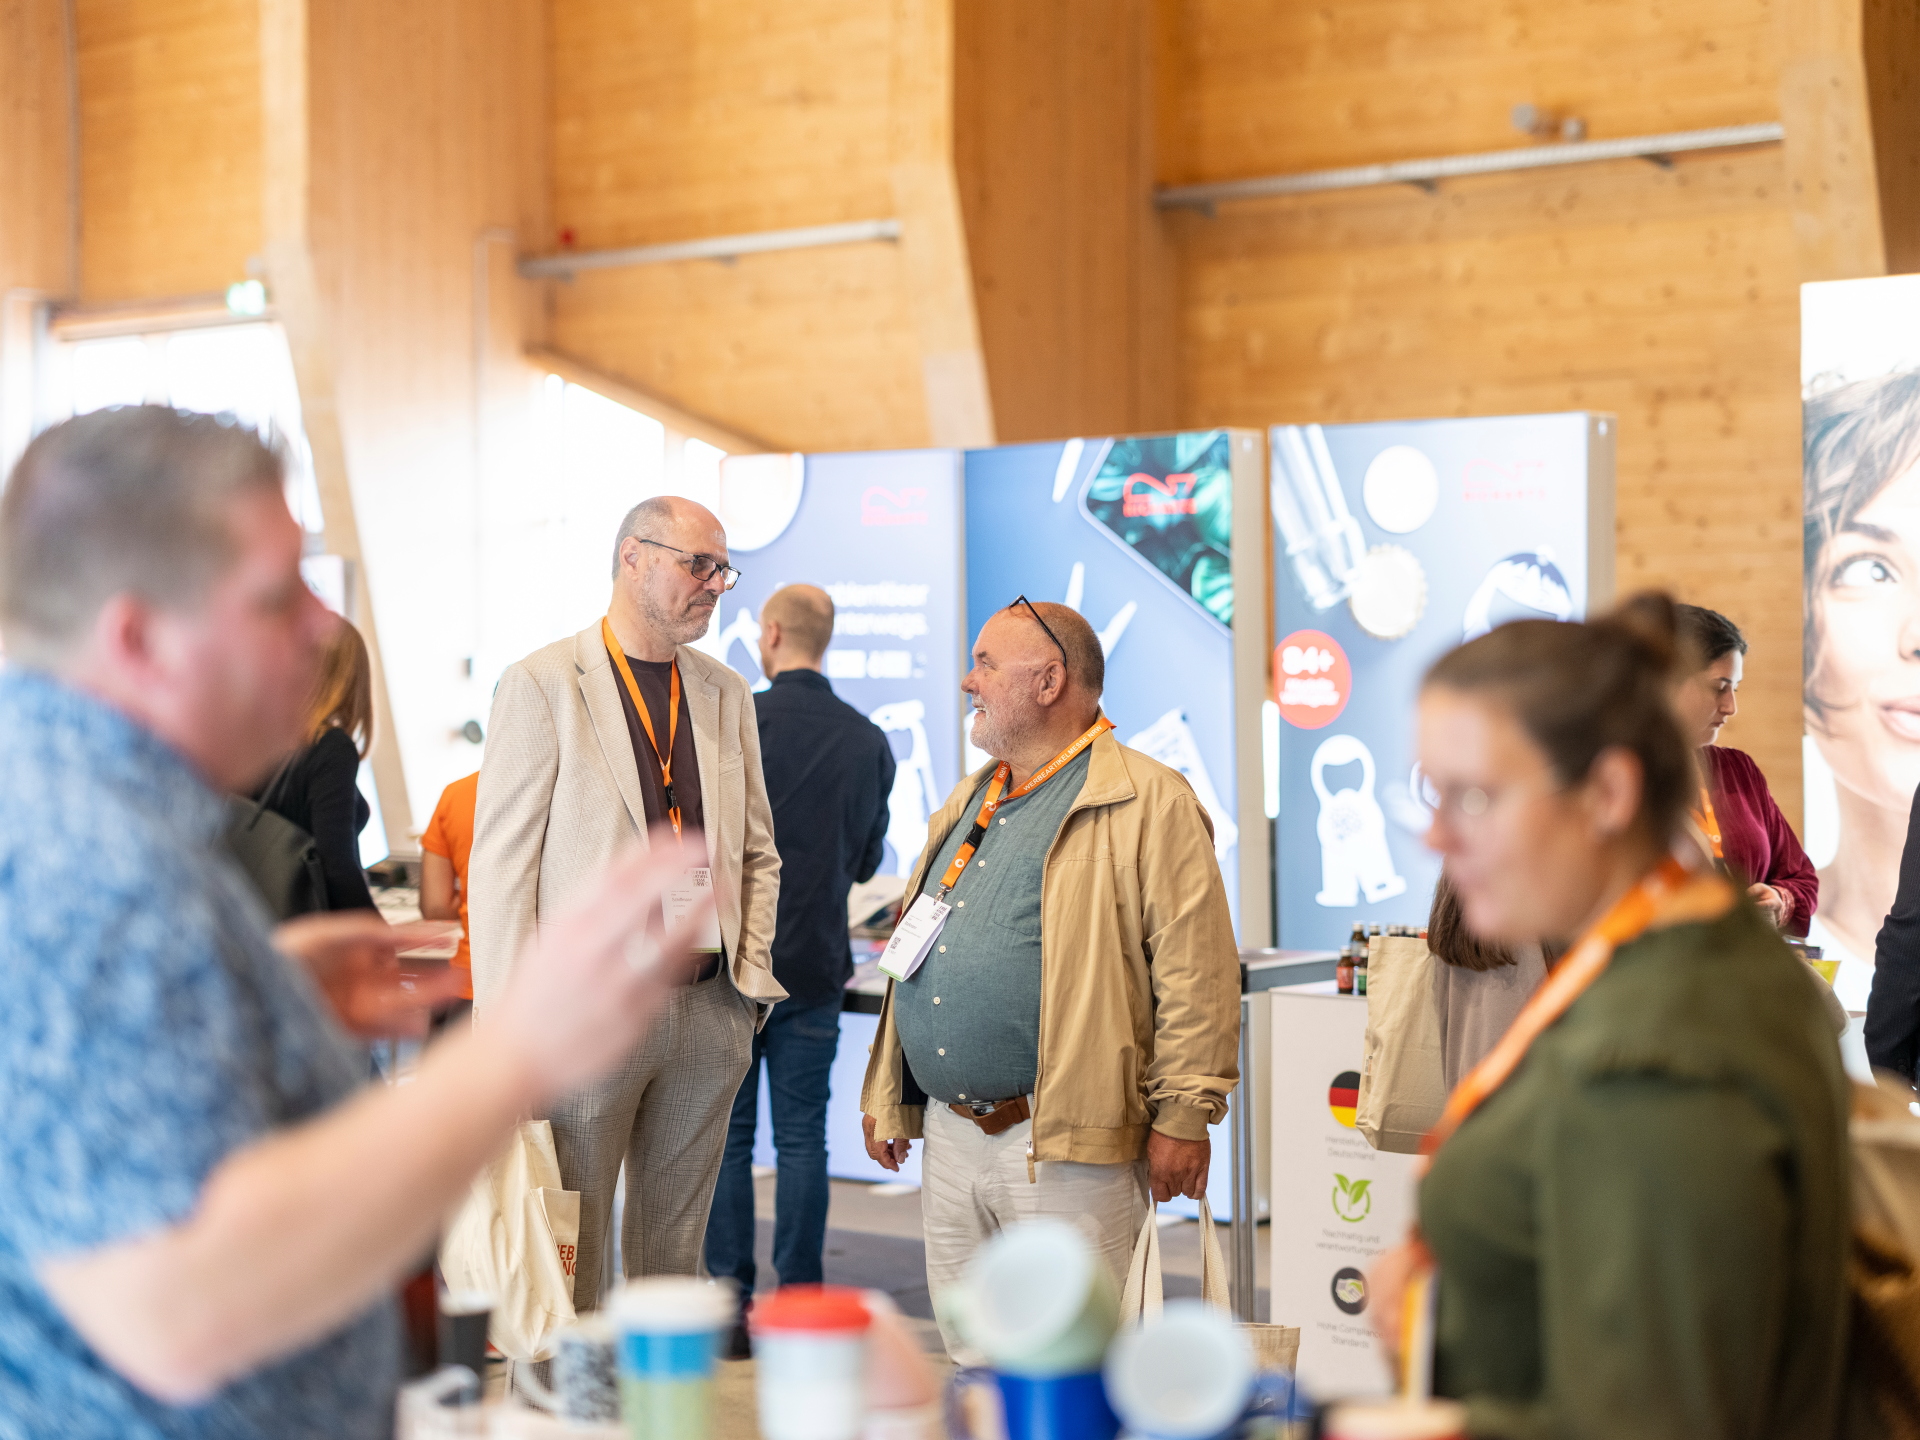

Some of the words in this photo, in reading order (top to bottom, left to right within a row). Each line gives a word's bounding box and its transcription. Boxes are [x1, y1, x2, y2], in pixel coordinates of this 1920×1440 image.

[1023, 736, 1090, 791] WERBEARTIKELMESSE
[1087, 725, 1103, 739] NRW
[1327, 1148, 1376, 1161] Deutschland
